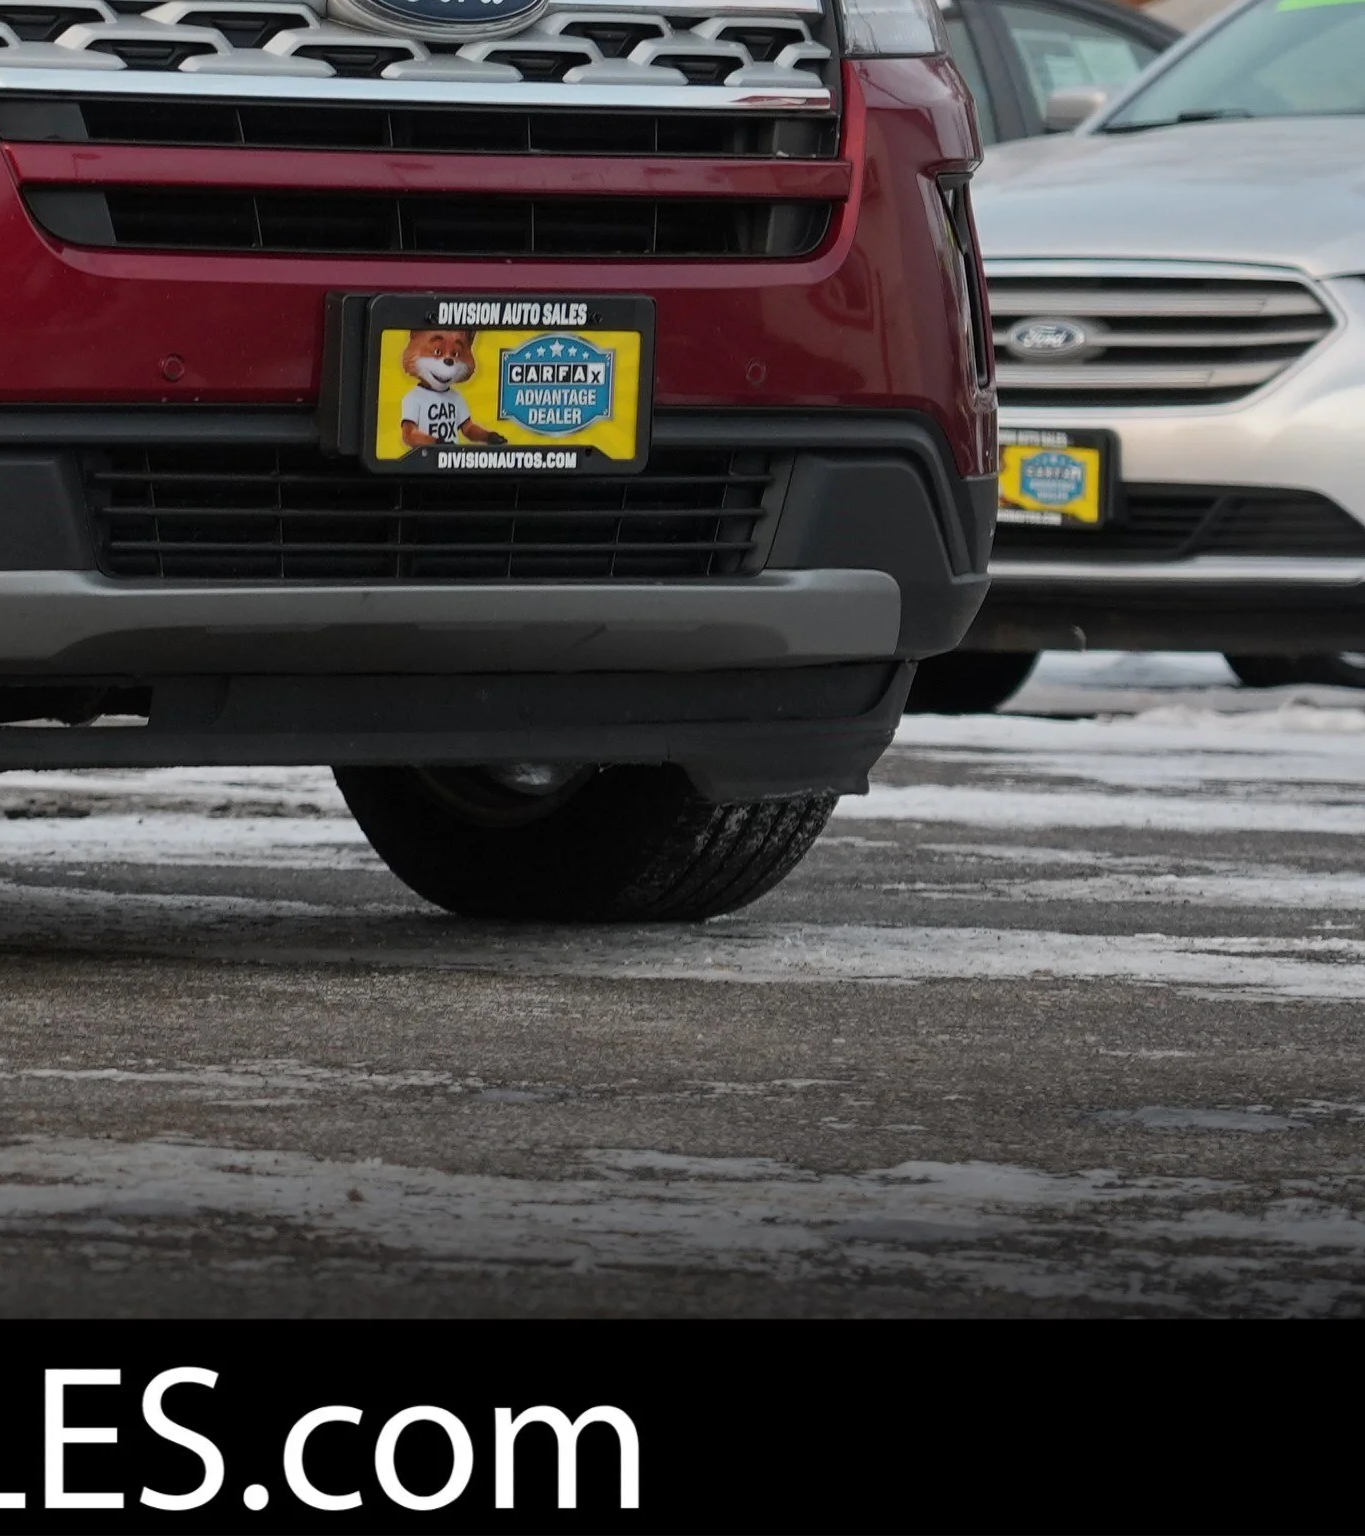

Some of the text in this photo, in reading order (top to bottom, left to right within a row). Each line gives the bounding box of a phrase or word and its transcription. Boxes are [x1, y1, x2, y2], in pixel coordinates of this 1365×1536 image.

[438, 302, 588, 325] DIVISION AUTO SALES
[510, 365, 603, 383] CARFAX
[515, 389, 596, 405] ADVANTAGE
[428, 402, 456, 420] CAR
[529, 408, 582, 424] DEALER
[428, 421, 456, 439] FOX
[438, 451, 577, 469] DIVISIONAUTOS.COM
